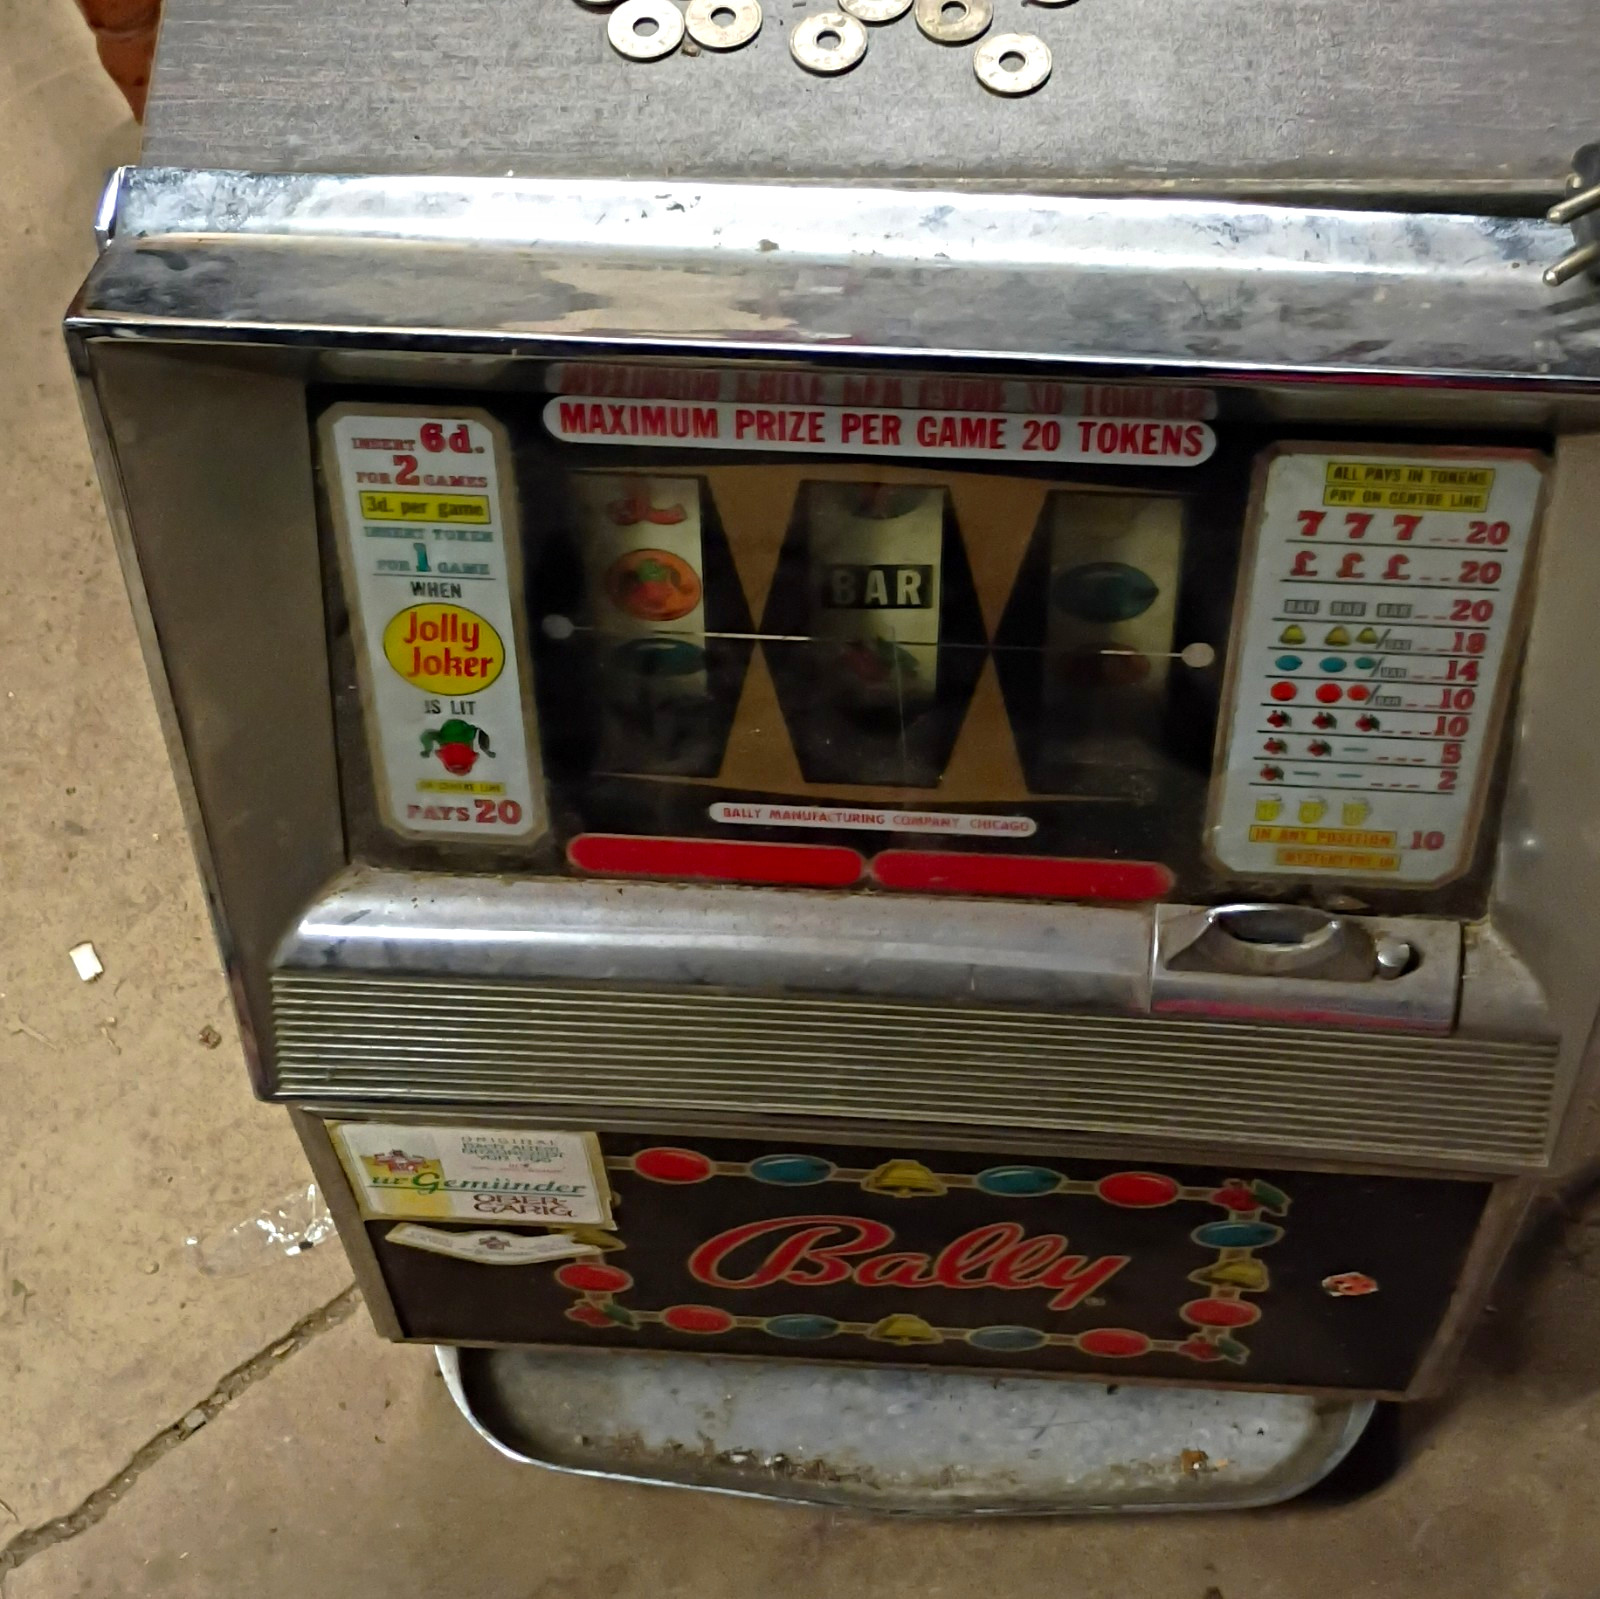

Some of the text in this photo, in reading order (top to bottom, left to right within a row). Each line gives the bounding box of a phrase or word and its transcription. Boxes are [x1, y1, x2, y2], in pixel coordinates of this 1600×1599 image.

[420, 423, 484, 453] 6d.
[560, 403, 1203, 456] MAXIMUM PRIZE PER GAME 20 TOKENS
[356, 454, 487, 488] FOR 2 GAMES
[1333, 466, 1489, 486] ALL PAYS IN TOKENS
[401, 502, 428, 516] per
[438, 503, 484, 518] game
[1330, 489, 1482, 508] PAY ON CENTRE LINE
[1297, 510, 1511, 545] 7 7 7 20
[413, 543, 431, 572] 1
[438, 562, 490, 575] GAME
[1289, 550, 1502, 585] £ £ £ 20
[410, 582, 462, 598] WHEN
[831, 570, 922, 605] BAR
[1450, 599, 1494, 622] 20
[404, 612, 479, 651] Jolly
[407, 647, 493, 678] Joker
[1445, 660, 1479, 682] 14
[424, 700, 476, 715] IS LIT
[1439, 688, 1476, 710] 10
[1434, 716, 1470, 737] 10
[1440, 743, 1462, 765] 5
[1437, 770, 1457, 791] 2
[407, 799, 522, 825] PAYS 20
[723, 807, 1029, 832] BALLY MANUFACTURING COMPANY CHICAGO
[1410, 830, 1446, 851] 10
[688, 1215, 1131, 1311] Bally
